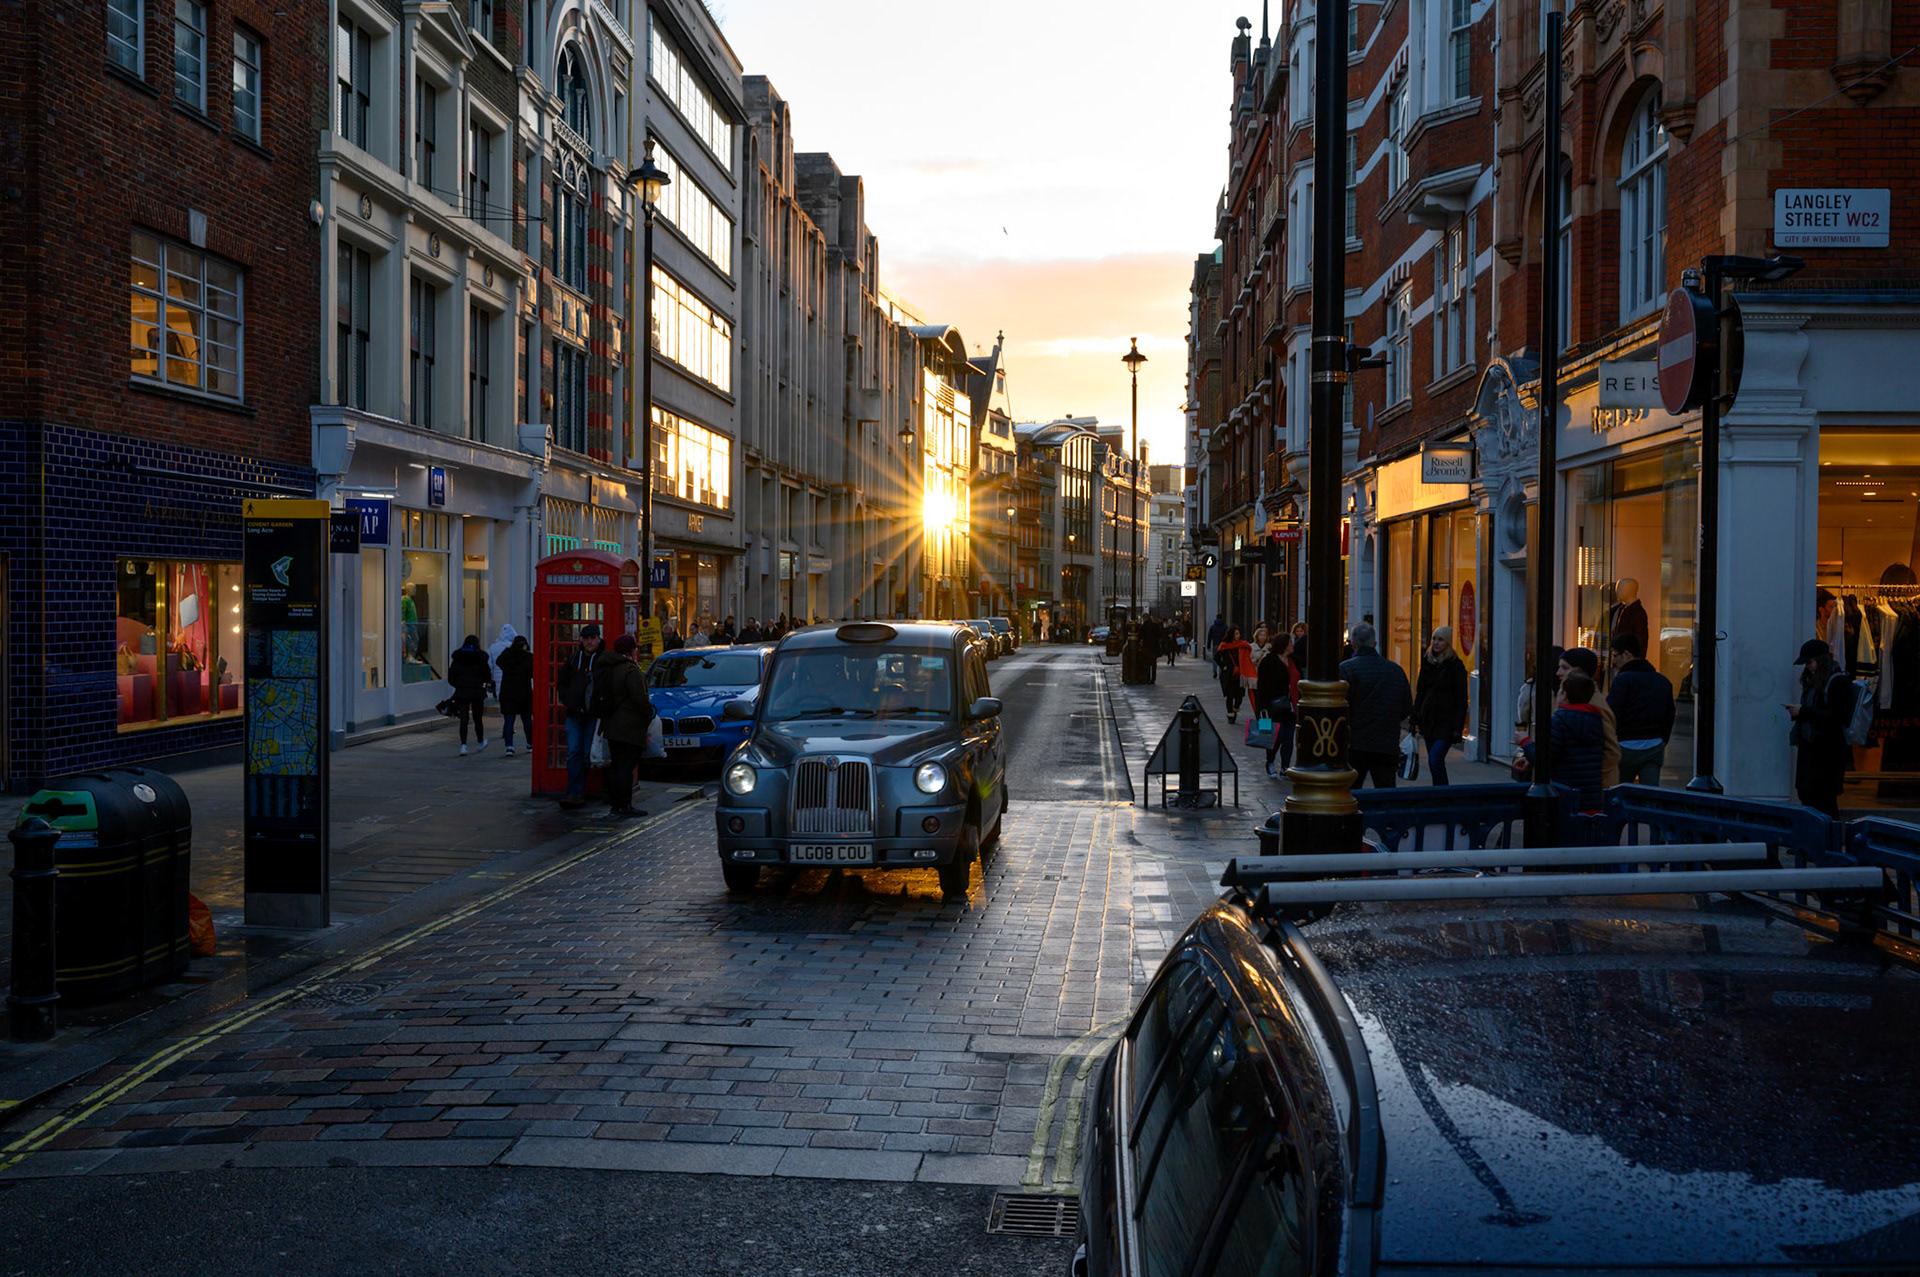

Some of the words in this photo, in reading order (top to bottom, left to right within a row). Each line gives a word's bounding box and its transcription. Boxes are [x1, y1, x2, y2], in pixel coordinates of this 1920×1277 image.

[1785, 194, 1852, 209] LANGLEY
[1785, 212, 1841, 227] STREET
[1846, 212, 1880, 227] WC2
[1784, 235, 1800, 243] CITY
[1802, 235, 1810, 243] OF
[1812, 235, 1861, 243] WESTMINSTER
[1605, 377, 1660, 391] REIS
[1431, 457, 1463, 467] Russell
[330, 524, 356, 533] INAL
[361, 515, 379, 535] AP
[549, 575, 608, 585] TELEPHONE
[1874, 716, 1920, 728] INUES
[796, 846, 833, 860] LG08
[838, 846, 867, 860] COU
